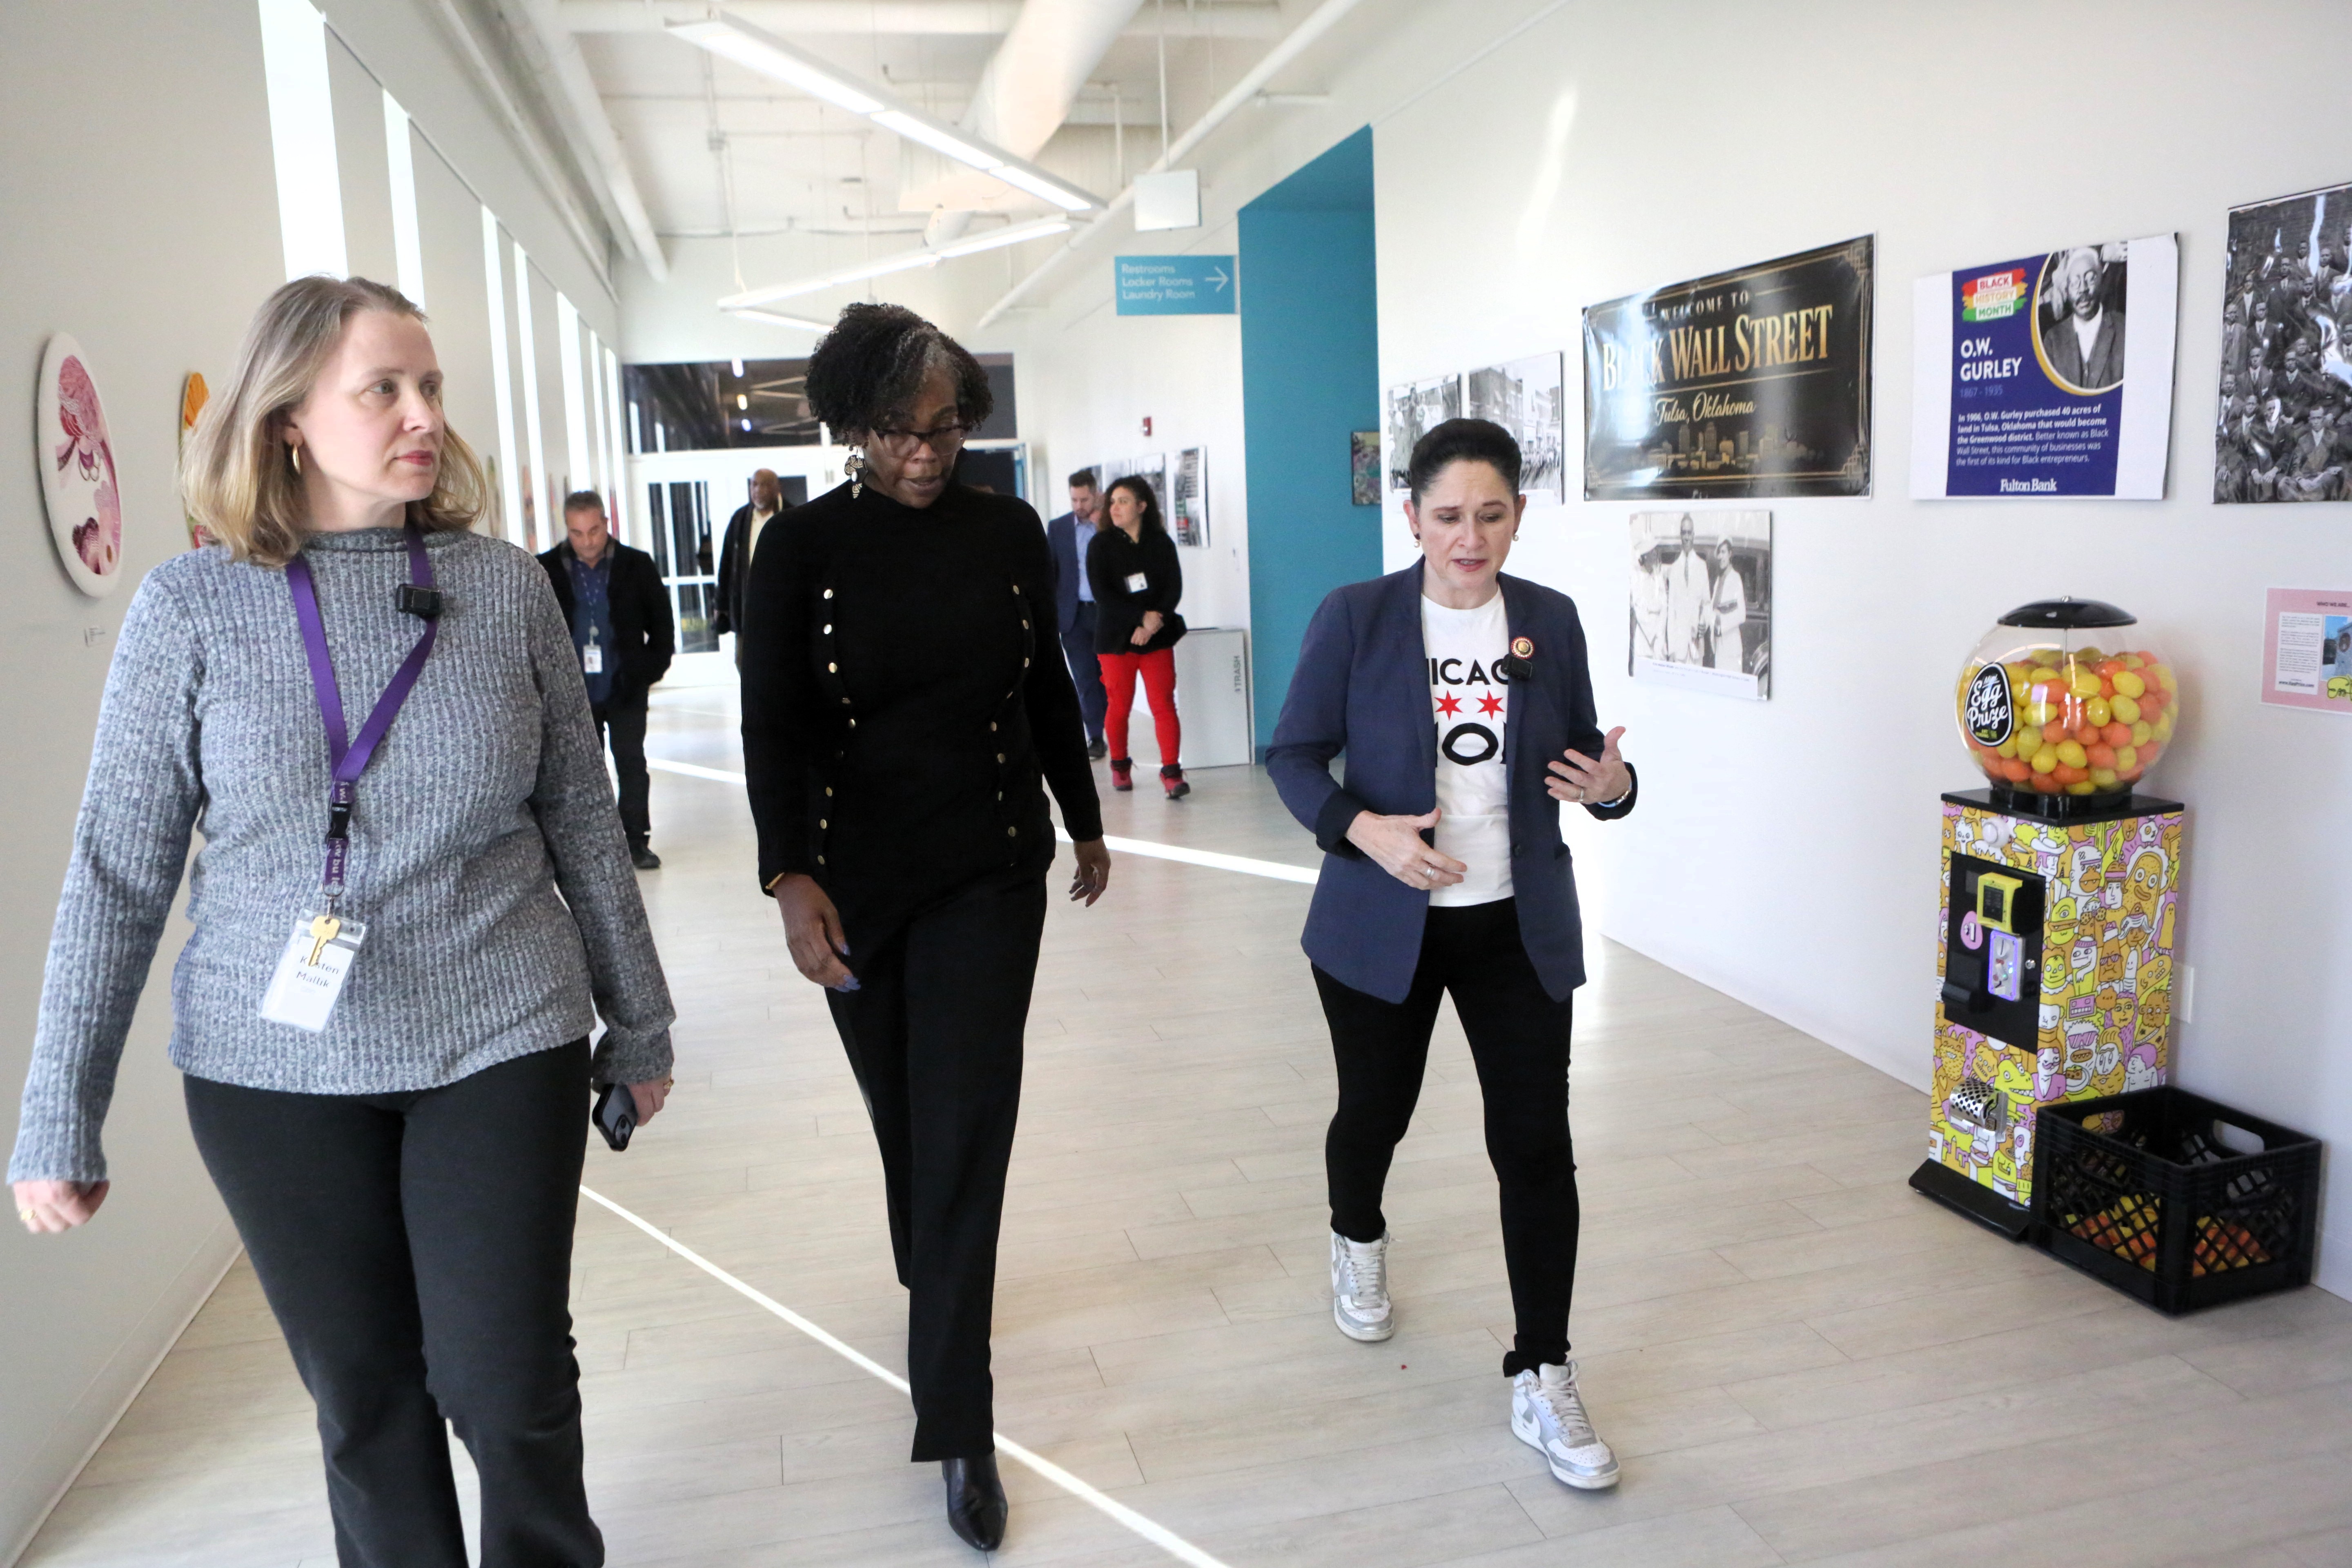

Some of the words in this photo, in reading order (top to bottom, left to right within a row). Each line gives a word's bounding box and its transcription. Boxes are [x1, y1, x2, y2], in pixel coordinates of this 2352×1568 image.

[1121, 263, 1176, 274] Restrooms
[1123, 277, 1156, 286] Locker
[1159, 276, 1193, 286] Rooms
[1980, 275, 2010, 290] BLACK
[1123, 289, 1163, 302] Laundry
[1165, 289, 1195, 299] Room
[1731, 290, 1748, 309] TO
[1976, 290, 2015, 303] HISTORY
[1978, 304, 2012, 318] MONTH
[1669, 325, 1731, 381] WALL
[1735, 304, 1833, 372] STREET
[1960, 336, 1993, 359] O.W.
[1960, 356, 2022, 381] GURLEY
[1655, 397, 1690, 426] Tulsa,
[1693, 391, 1756, 422] Oklahoma
[1958, 414, 1965, 422] In
[1984, 411, 1999, 421] O.W.
[2001, 410, 2023, 421] Gurley
[2024, 406, 2061, 421] purchased
[2062, 406, 2070, 415] 40
[2072, 406, 2091, 415] acres
[2093, 403, 2102, 413] of
[1958, 424, 1972, 434] land
[1973, 423, 1980, 433] in
[1981, 423, 2000, 433] Tulsa,
[2002, 421, 2036, 431] Oklahoma
[2038, 419, 2053, 429] that
[2054, 417, 2076, 428] would
[2078, 417, 2107, 427] become
[1957, 435, 1969, 445] the
[1969, 433, 2007, 444] Greenwood
[2008, 432, 2034, 442] district.
[2036, 431, 2056, 441] Better
[2057, 430, 2079, 439] known
[2090, 428, 2109, 438] Black
[1991, 445, 2003, 454] this
[2004, 444, 2040, 454] community
[2042, 442, 2049, 452] of
[2049, 442, 2086, 451] businesses
[2087, 442, 2101, 450] was
[1956, 457, 1966, 466] the
[1967, 457, 1980, 466] first
[1980, 456, 1987, 466] of
[1996, 456, 2011, 465] kind
[2011, 455, 2020, 464] for
[2022, 454, 2039, 464] Black
[2000, 478, 2030, 492] Fulton
[2031, 478, 2058, 492] Bank
[1971, 679, 2003, 710] Egg
[1967, 705, 2008, 731] Prize
